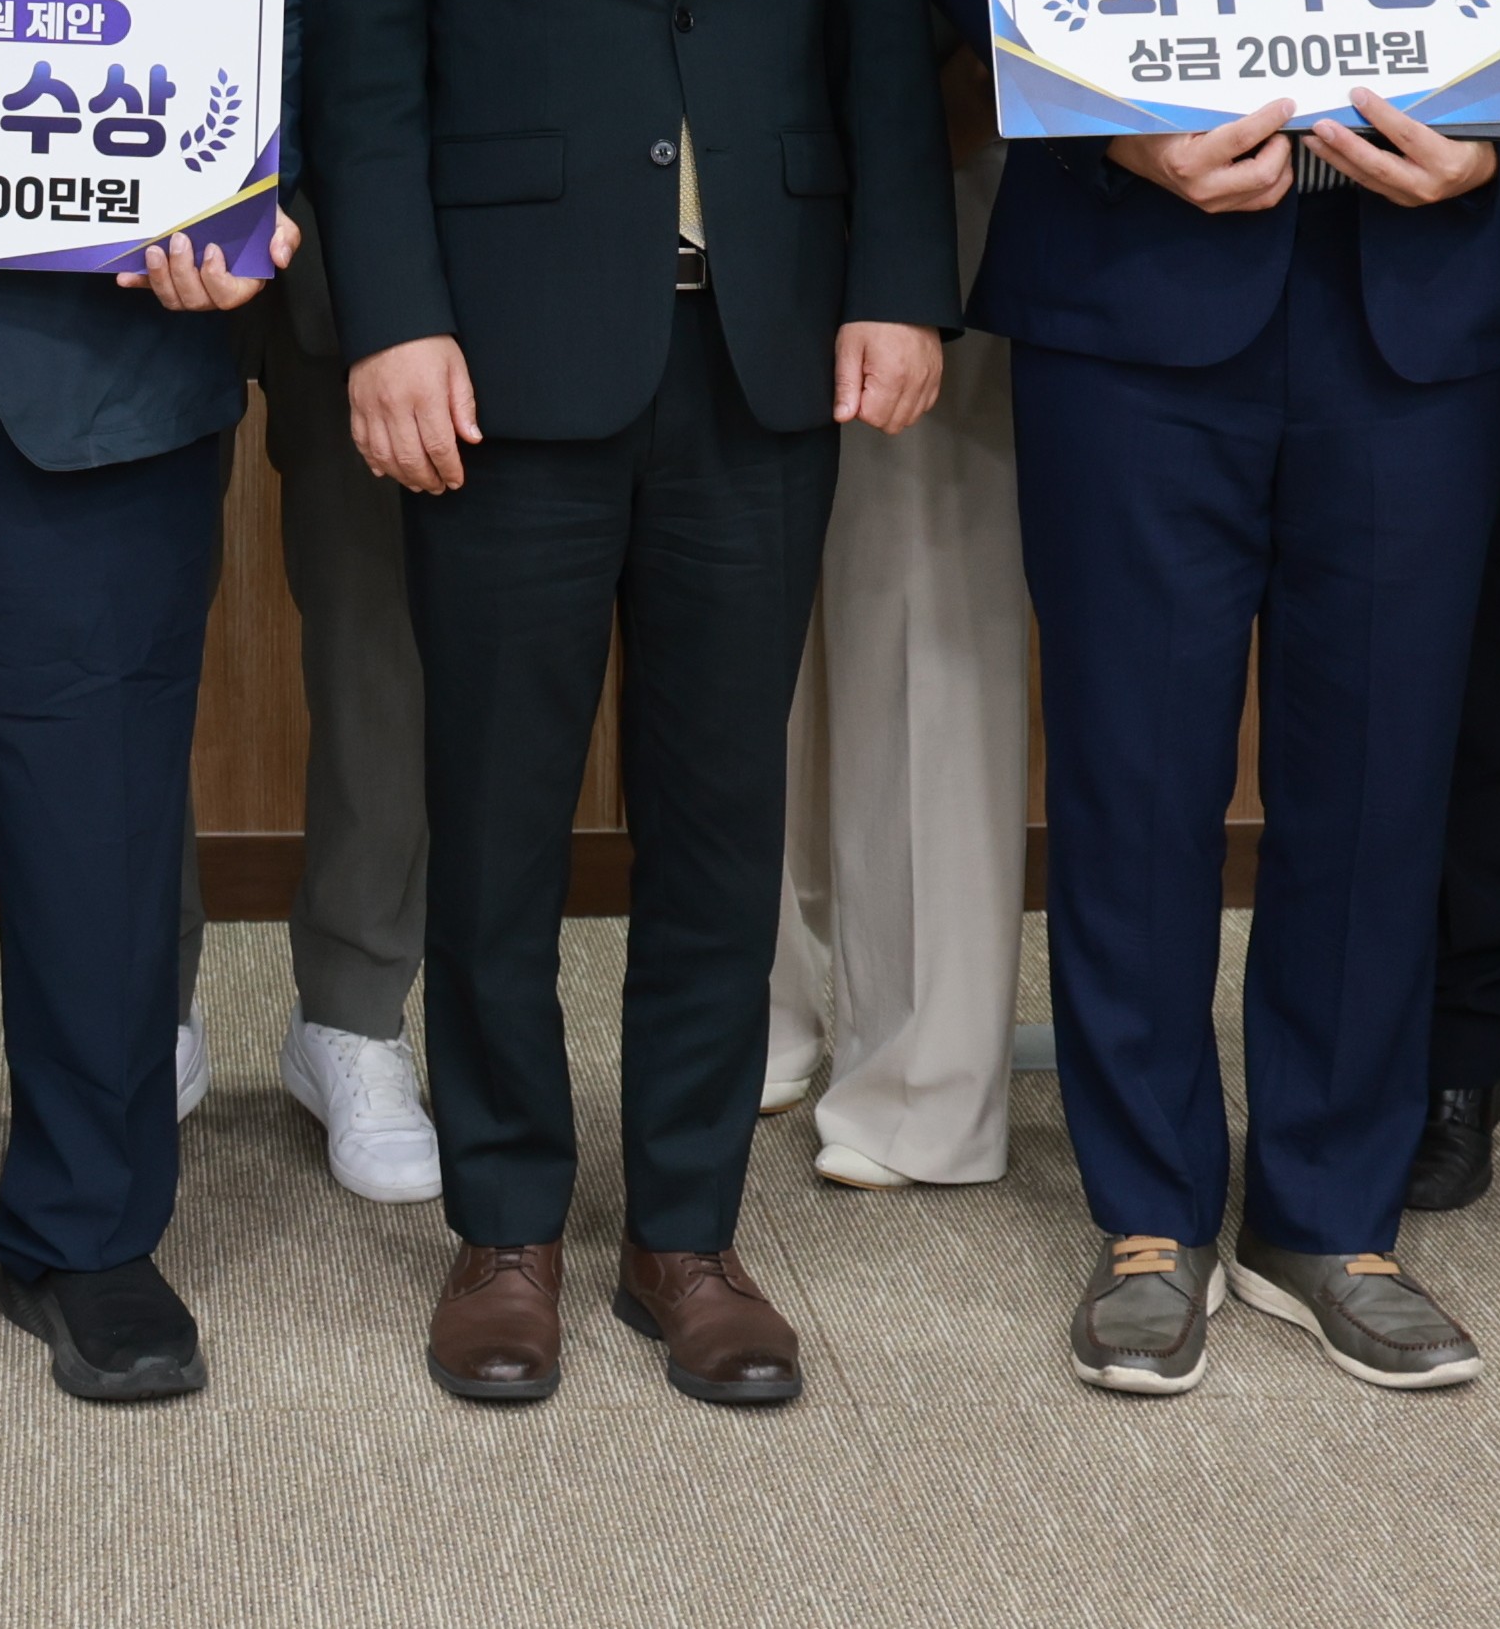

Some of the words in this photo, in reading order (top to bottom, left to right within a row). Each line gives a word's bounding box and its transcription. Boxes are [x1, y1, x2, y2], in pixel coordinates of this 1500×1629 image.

[27, 2, 104, 41] 제안
[1129, 37, 1220, 82] 상금
[1237, 30, 1428, 78] 200만원
